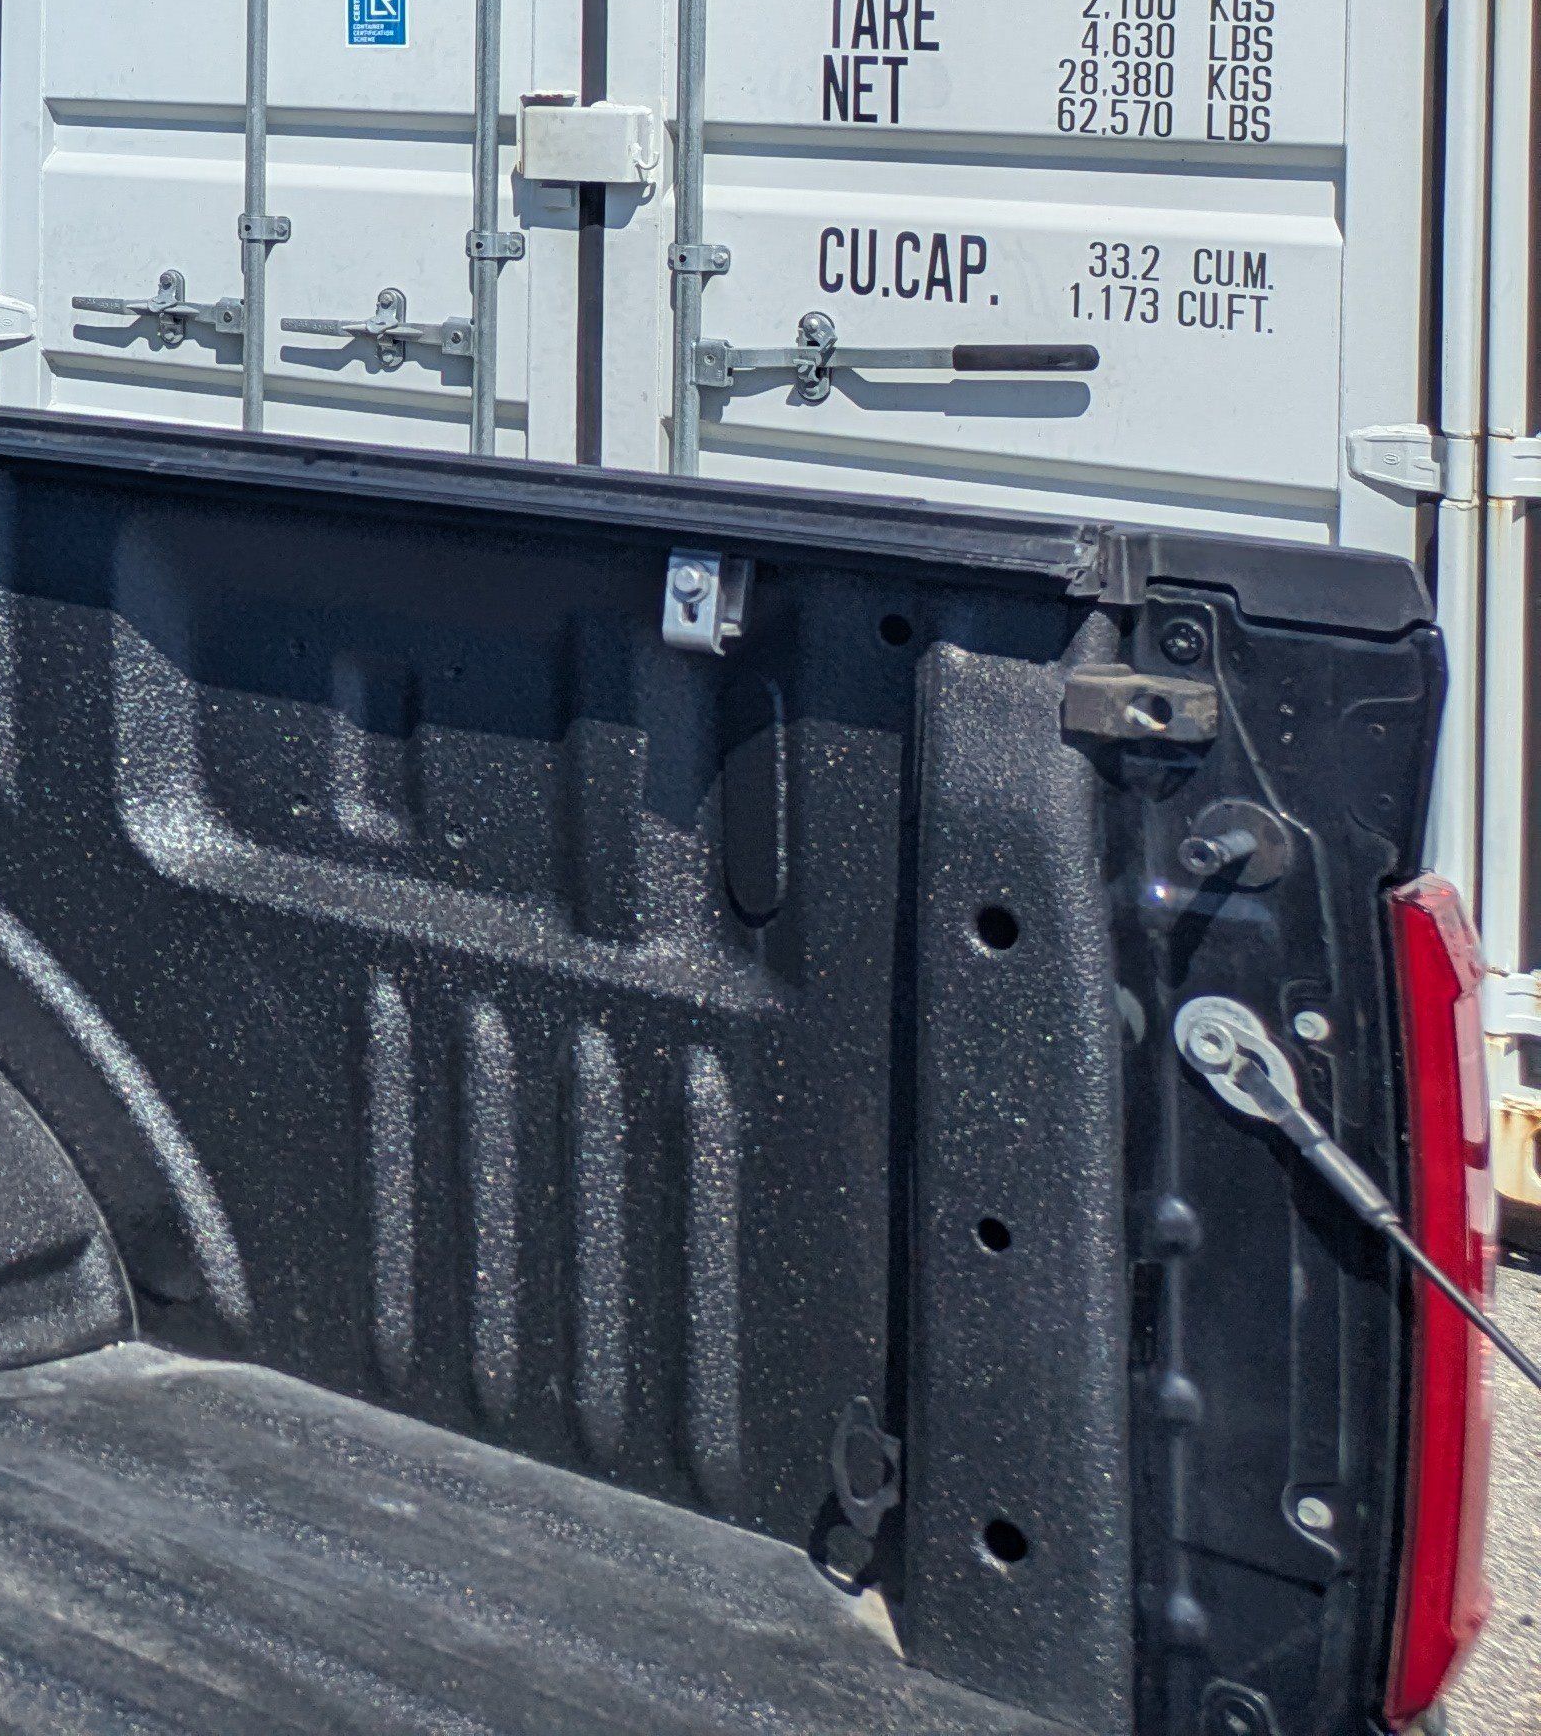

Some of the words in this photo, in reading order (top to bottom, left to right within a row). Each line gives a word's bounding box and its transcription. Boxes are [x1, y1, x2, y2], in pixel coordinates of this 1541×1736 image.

[1081, 21, 1174, 59] 4,630
[1208, 24, 1273, 62] LBS
[822, 55, 909, 125] NET
[1058, 58, 1174, 98] 28,380
[1207, 63, 1272, 103] KGS
[1057, 97, 1173, 138] 62,570
[1206, 102, 1272, 143] LBS
[1089, 241, 1160, 282] 33.2
[1193, 248, 1274, 290] CU.M.
[1178, 290, 1273, 334] CU.FT.
